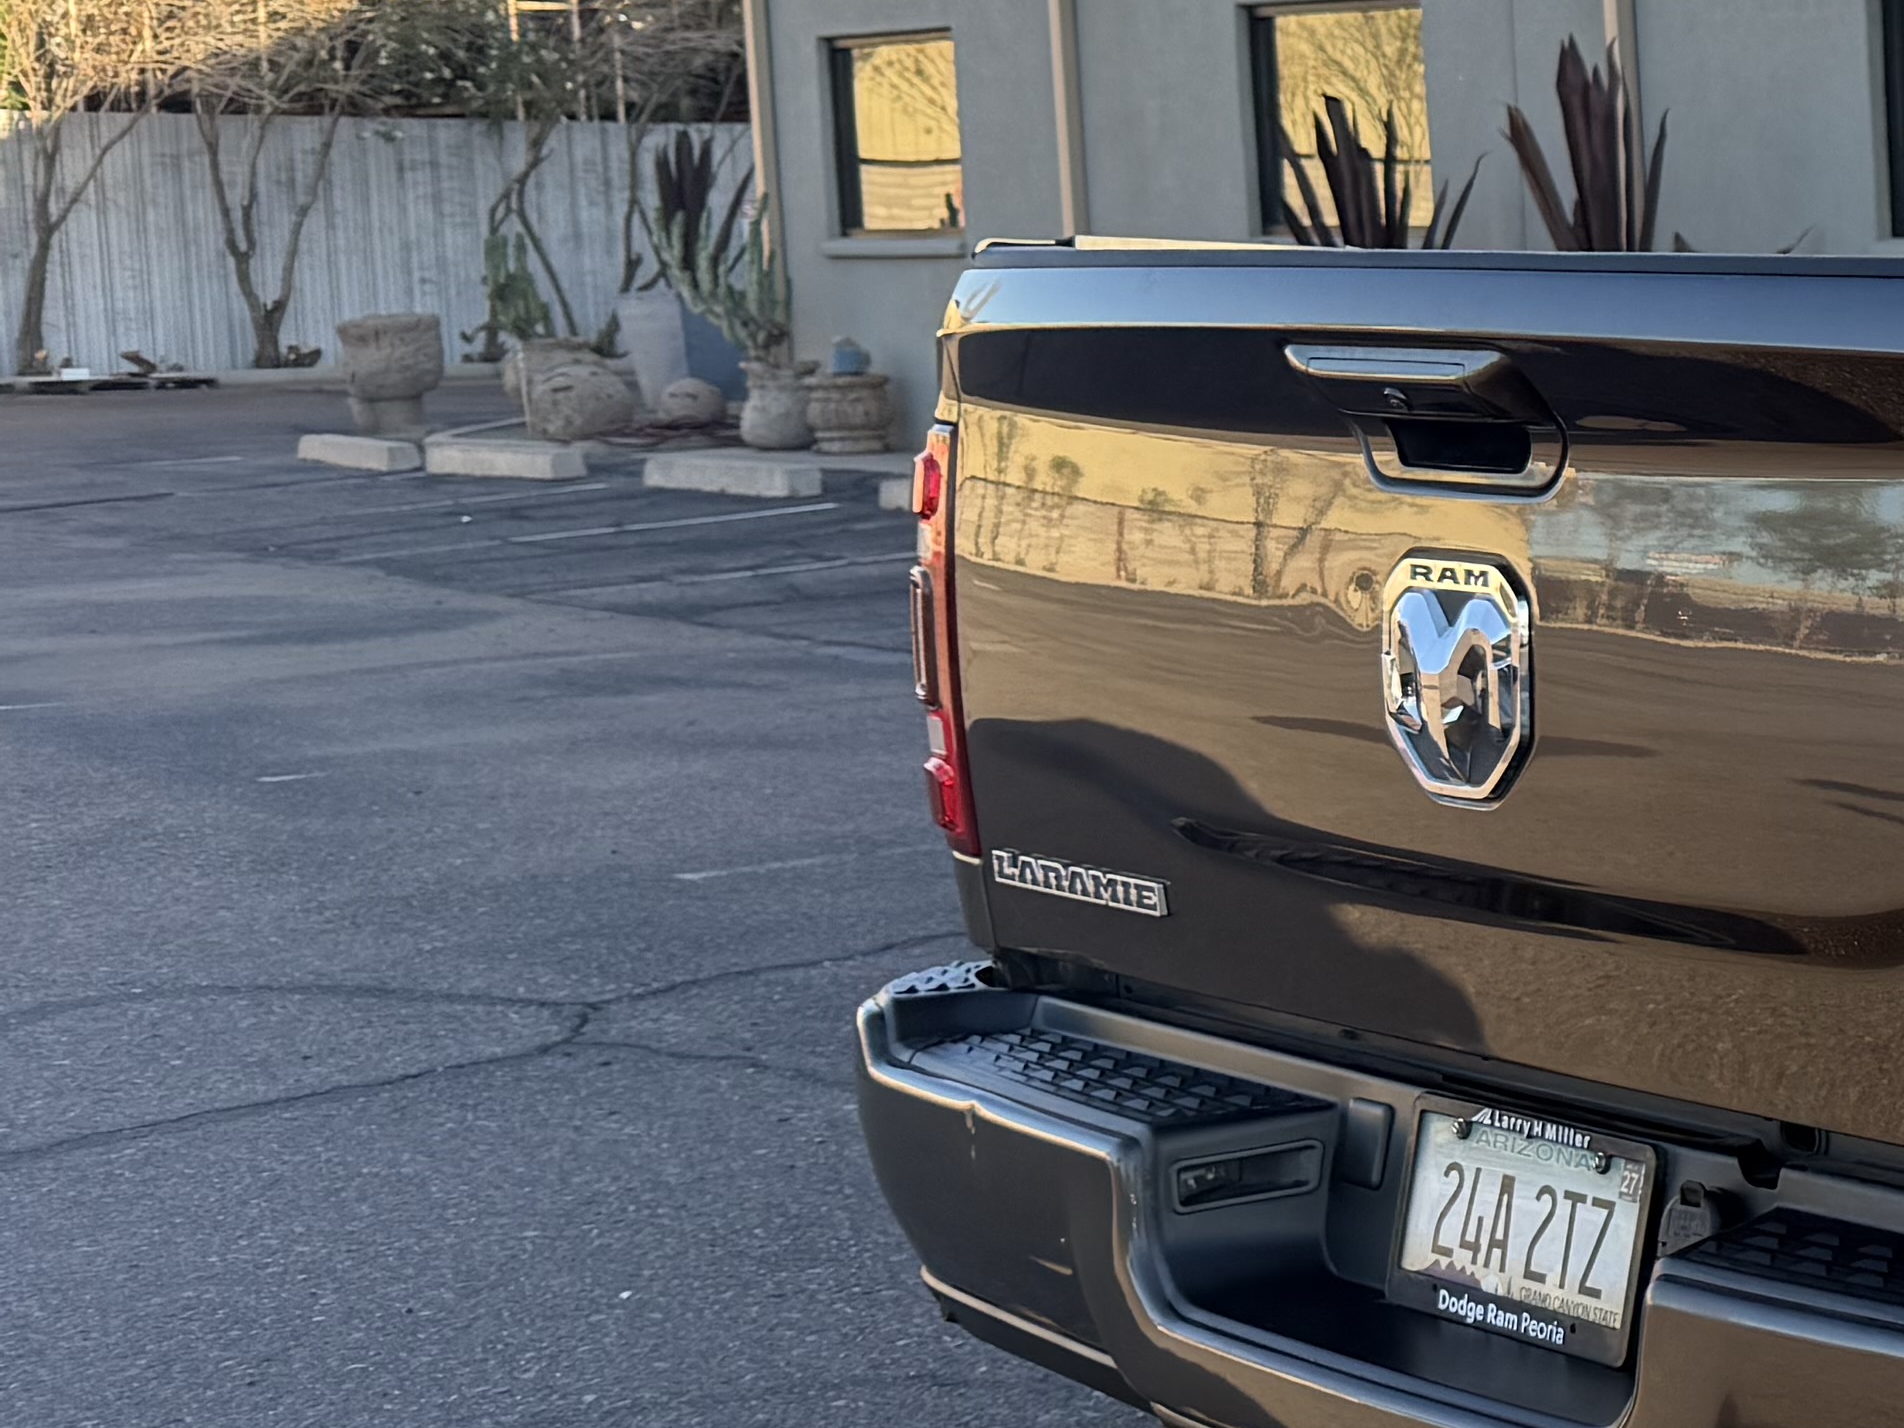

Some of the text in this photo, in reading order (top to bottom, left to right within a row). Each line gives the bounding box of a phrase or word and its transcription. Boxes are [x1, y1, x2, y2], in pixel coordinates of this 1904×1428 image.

[1409, 563, 1490, 588] RAM
[992, 849, 1168, 917] LARAMIE
[1475, 1128, 1595, 1172] ARIZONA
[1495, 1110, 1591, 1149] Larry H Miller
[1621, 1170, 1640, 1194] 27
[1431, 1161, 1616, 1300] 24A 2TZ
[1437, 1288, 1564, 1345] Dodge Ram Peoria
[1519, 1286, 1620, 1329] GRAND CANYON STATE
